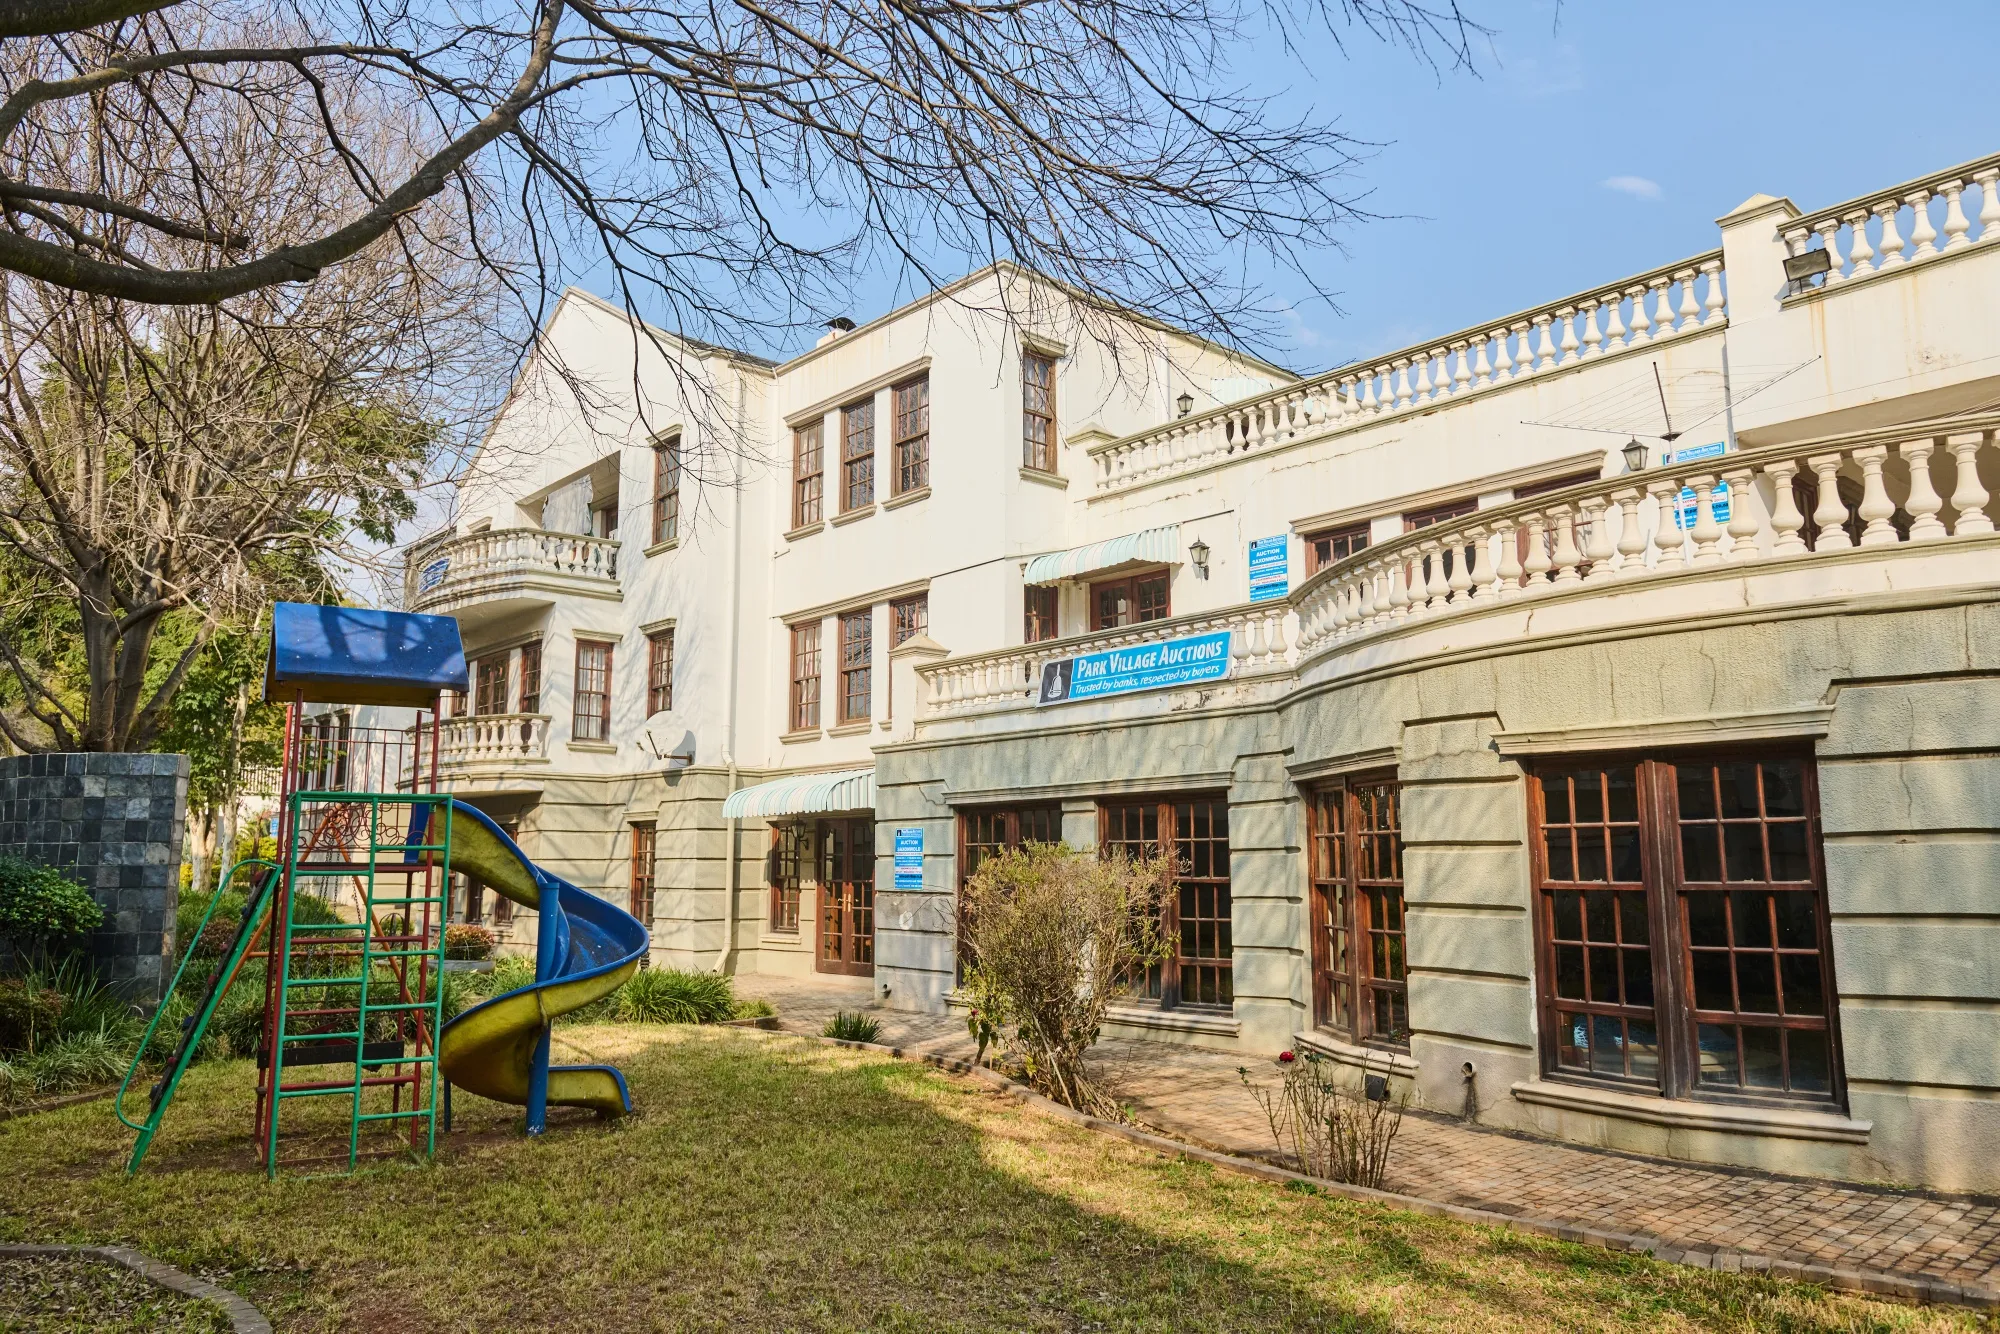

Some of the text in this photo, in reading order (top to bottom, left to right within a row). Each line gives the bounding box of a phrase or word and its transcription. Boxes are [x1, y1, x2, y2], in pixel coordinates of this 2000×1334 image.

[1256, 548, 1280, 557] AUCTION
[1077, 641, 1223, 679] PARK VILLAGE AUCTIONS
[1075, 665, 1219, 694] Trusted by banks, respected by buyers
